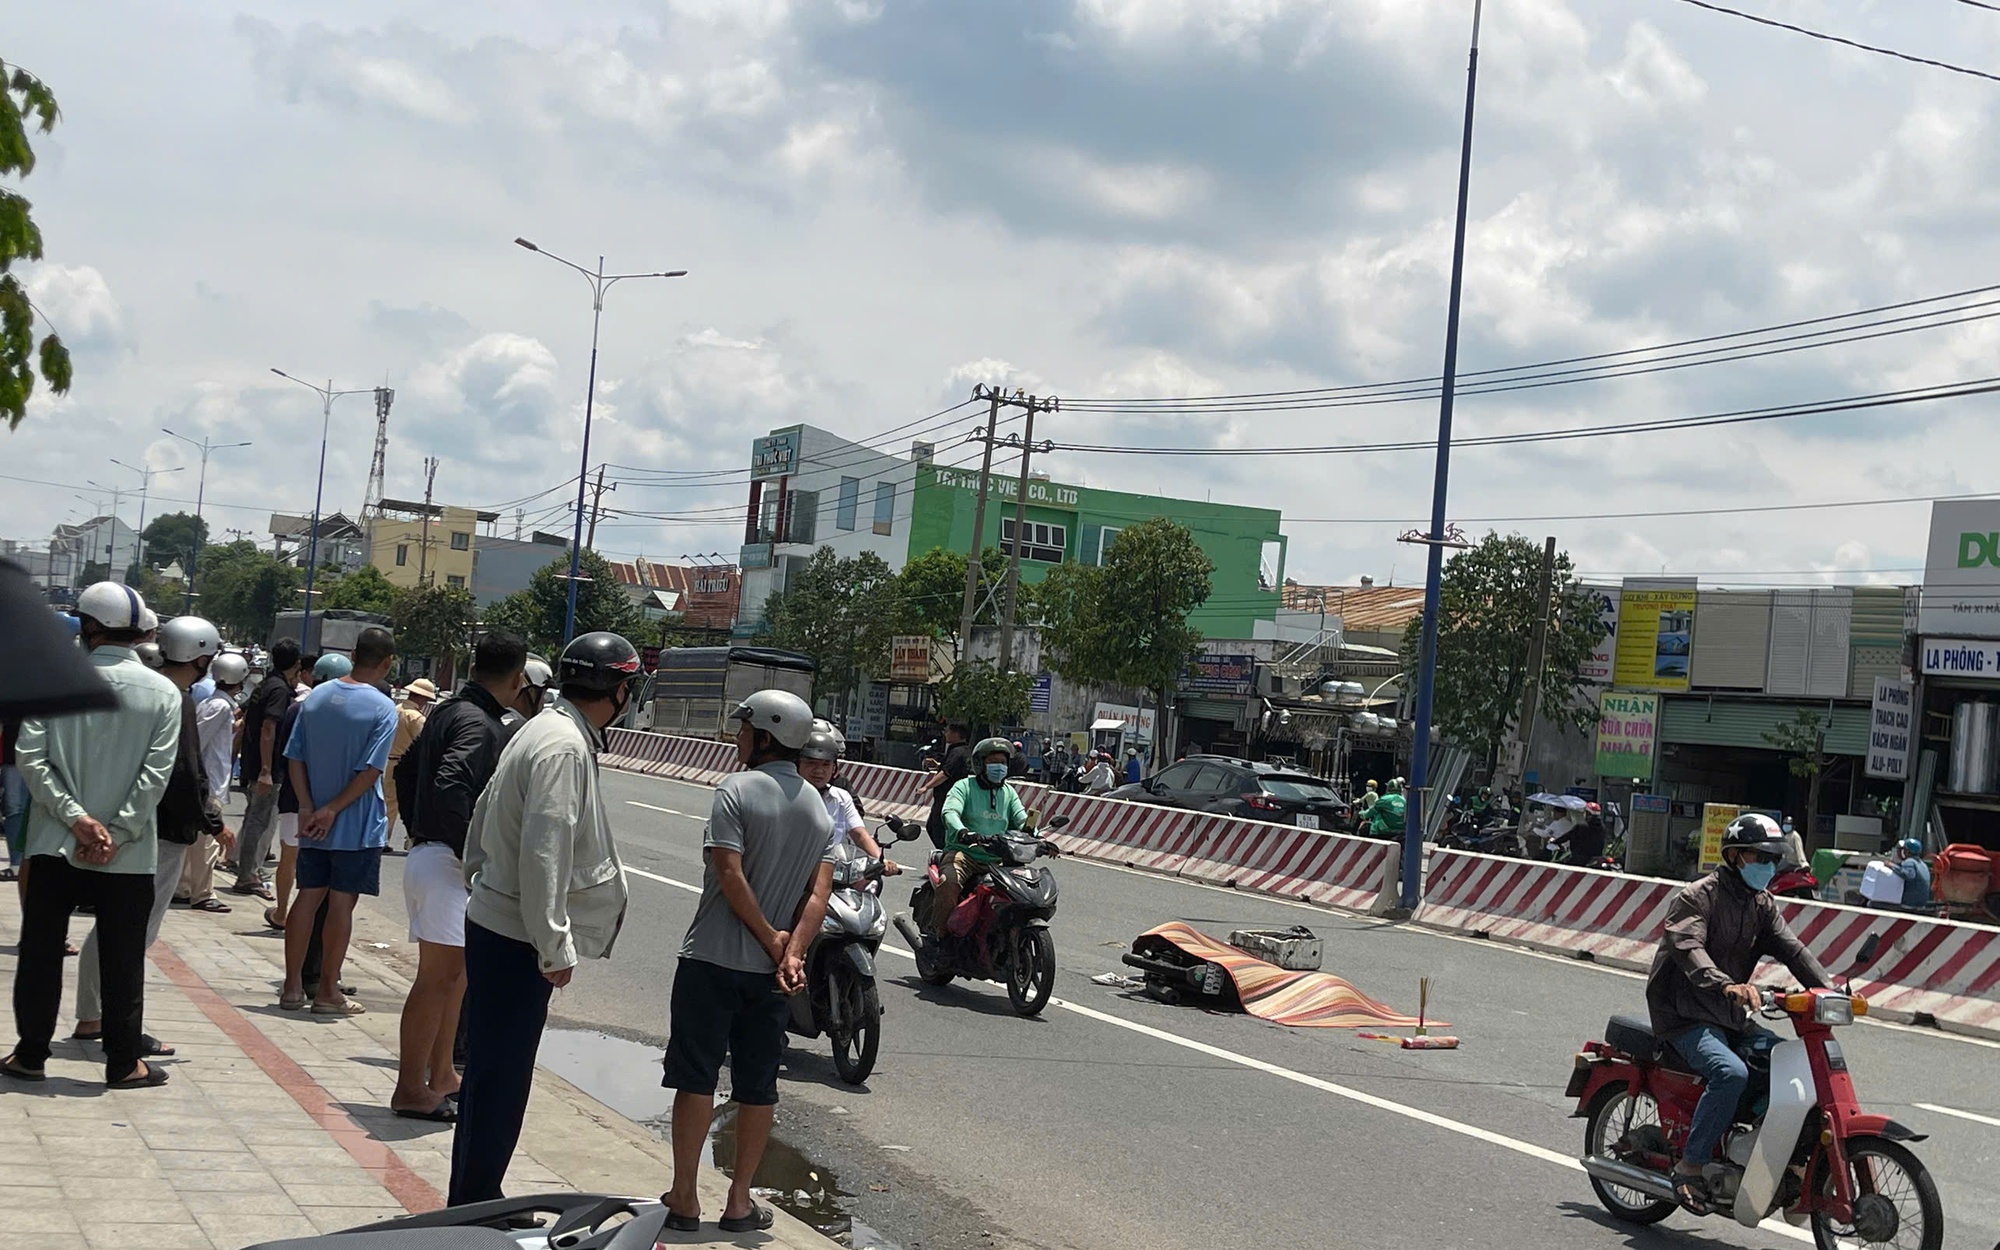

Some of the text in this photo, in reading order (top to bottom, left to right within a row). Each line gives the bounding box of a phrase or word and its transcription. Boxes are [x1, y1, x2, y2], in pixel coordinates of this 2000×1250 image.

[1028, 484, 1053, 503] CO.,
[1057, 488, 1078, 505] LTD
[1926, 649, 1940, 670] LA
[1943, 645, 1984, 672] PHÔNG
[1604, 697, 1654, 716] NHẬN
[1131, 714, 1151, 729] TNG
